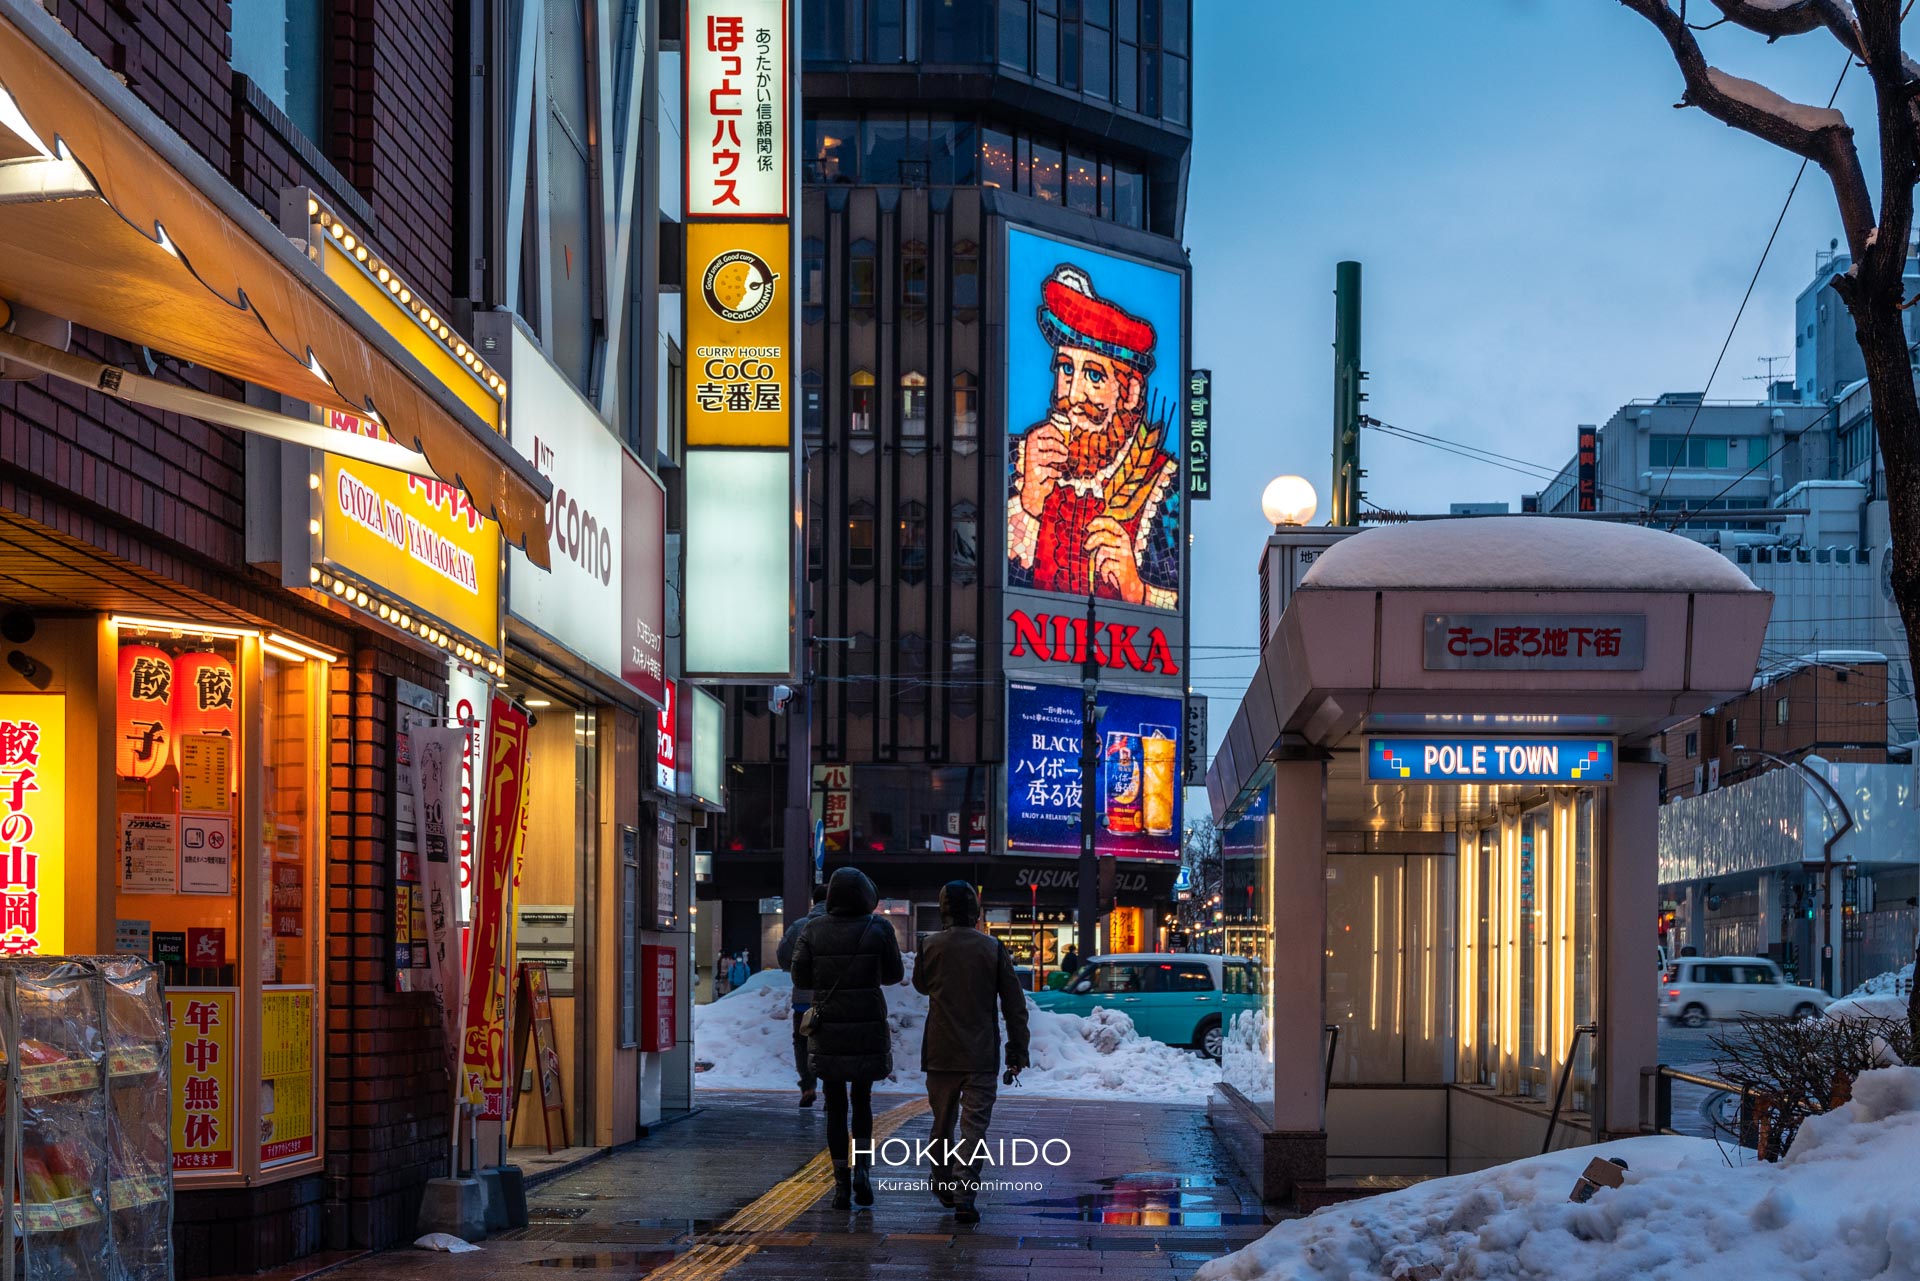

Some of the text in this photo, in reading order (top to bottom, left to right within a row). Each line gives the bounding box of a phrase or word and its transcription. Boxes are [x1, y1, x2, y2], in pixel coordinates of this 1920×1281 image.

[707, 16, 744, 206] ほっとハウス
[755, 28, 773, 172] あったかい信頼関係
[723, 253, 740, 262] Good
[740, 254, 755, 263] curry
[697, 347, 780, 357] CURRY HOUSE
[705, 360, 773, 380] CoCo
[697, 382, 780, 411] 壱番屋
[540, 441, 554, 472] NTT
[338, 472, 384, 534] GYOZA
[385, 503, 404, 546] NO
[407, 518, 477, 590] YAMAOKAYA
[1008, 609, 1180, 676] NIKKA
[1448, 627, 1622, 657] さっぽろ地下街
[126, 658, 171, 760] 餃子
[197, 668, 234, 736] 餃
[1031, 733, 1080, 754] BLACK
[1425, 746, 1558, 774] POLE TOWN
[158, 943, 180, 953] Uber
[185, 1001, 219, 1149] 年中無休
